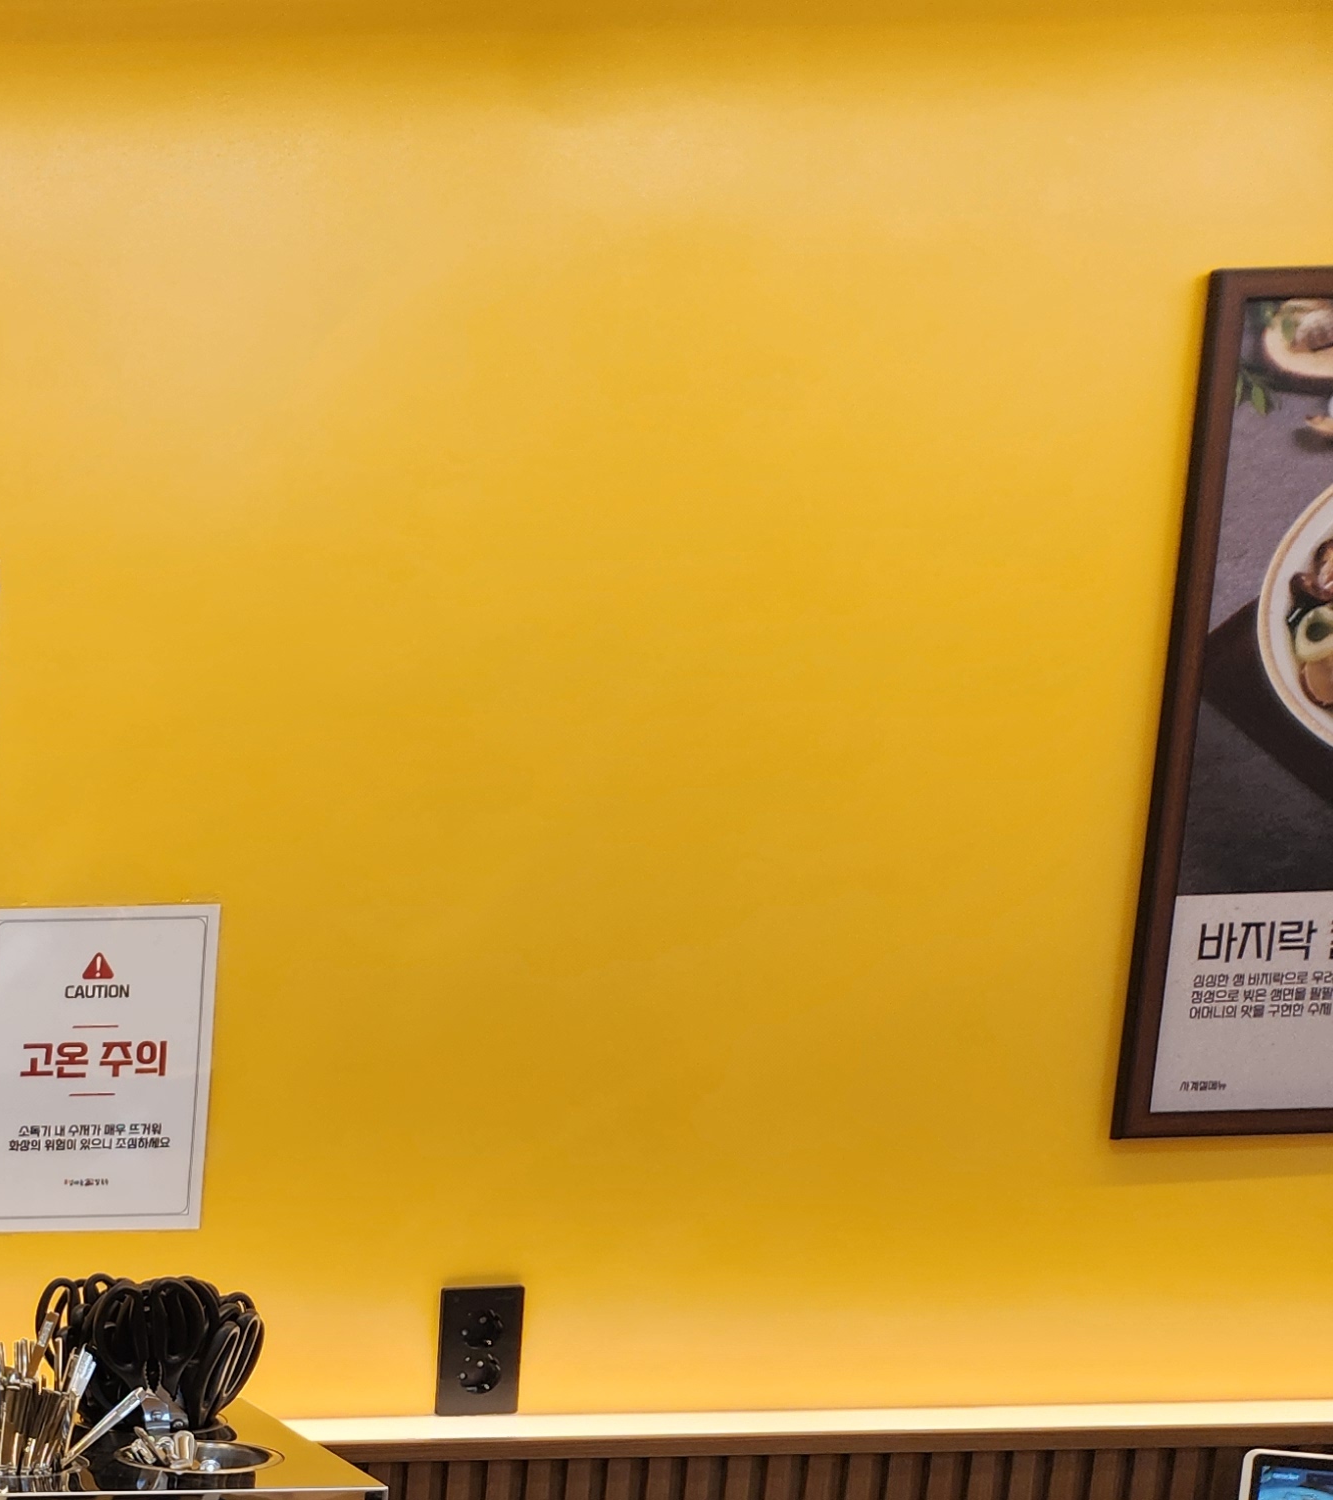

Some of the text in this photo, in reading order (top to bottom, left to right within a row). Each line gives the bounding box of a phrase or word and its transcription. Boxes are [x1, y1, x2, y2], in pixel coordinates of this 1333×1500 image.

[1197, 920, 1318, 963] 바지락
[1193, 973, 1229, 988] 싱싱한
[1233, 973, 1245, 987] 생
[1248, 971, 1308, 986] 바지락으로
[64, 984, 130, 999] CAUTION
[1191, 989, 1239, 1004] 정성으로
[1189, 1005, 1237, 1020] 어머니의
[1241, 1004, 1265, 1019] 맛을
[19, 1040, 168, 1078] 고온 주의
[18, 1123, 162, 1137] 소독기 내 수저가 매우 뜨거워
[9, 1137, 170, 1151] 화상의 위험이 있으니 조심하세요
